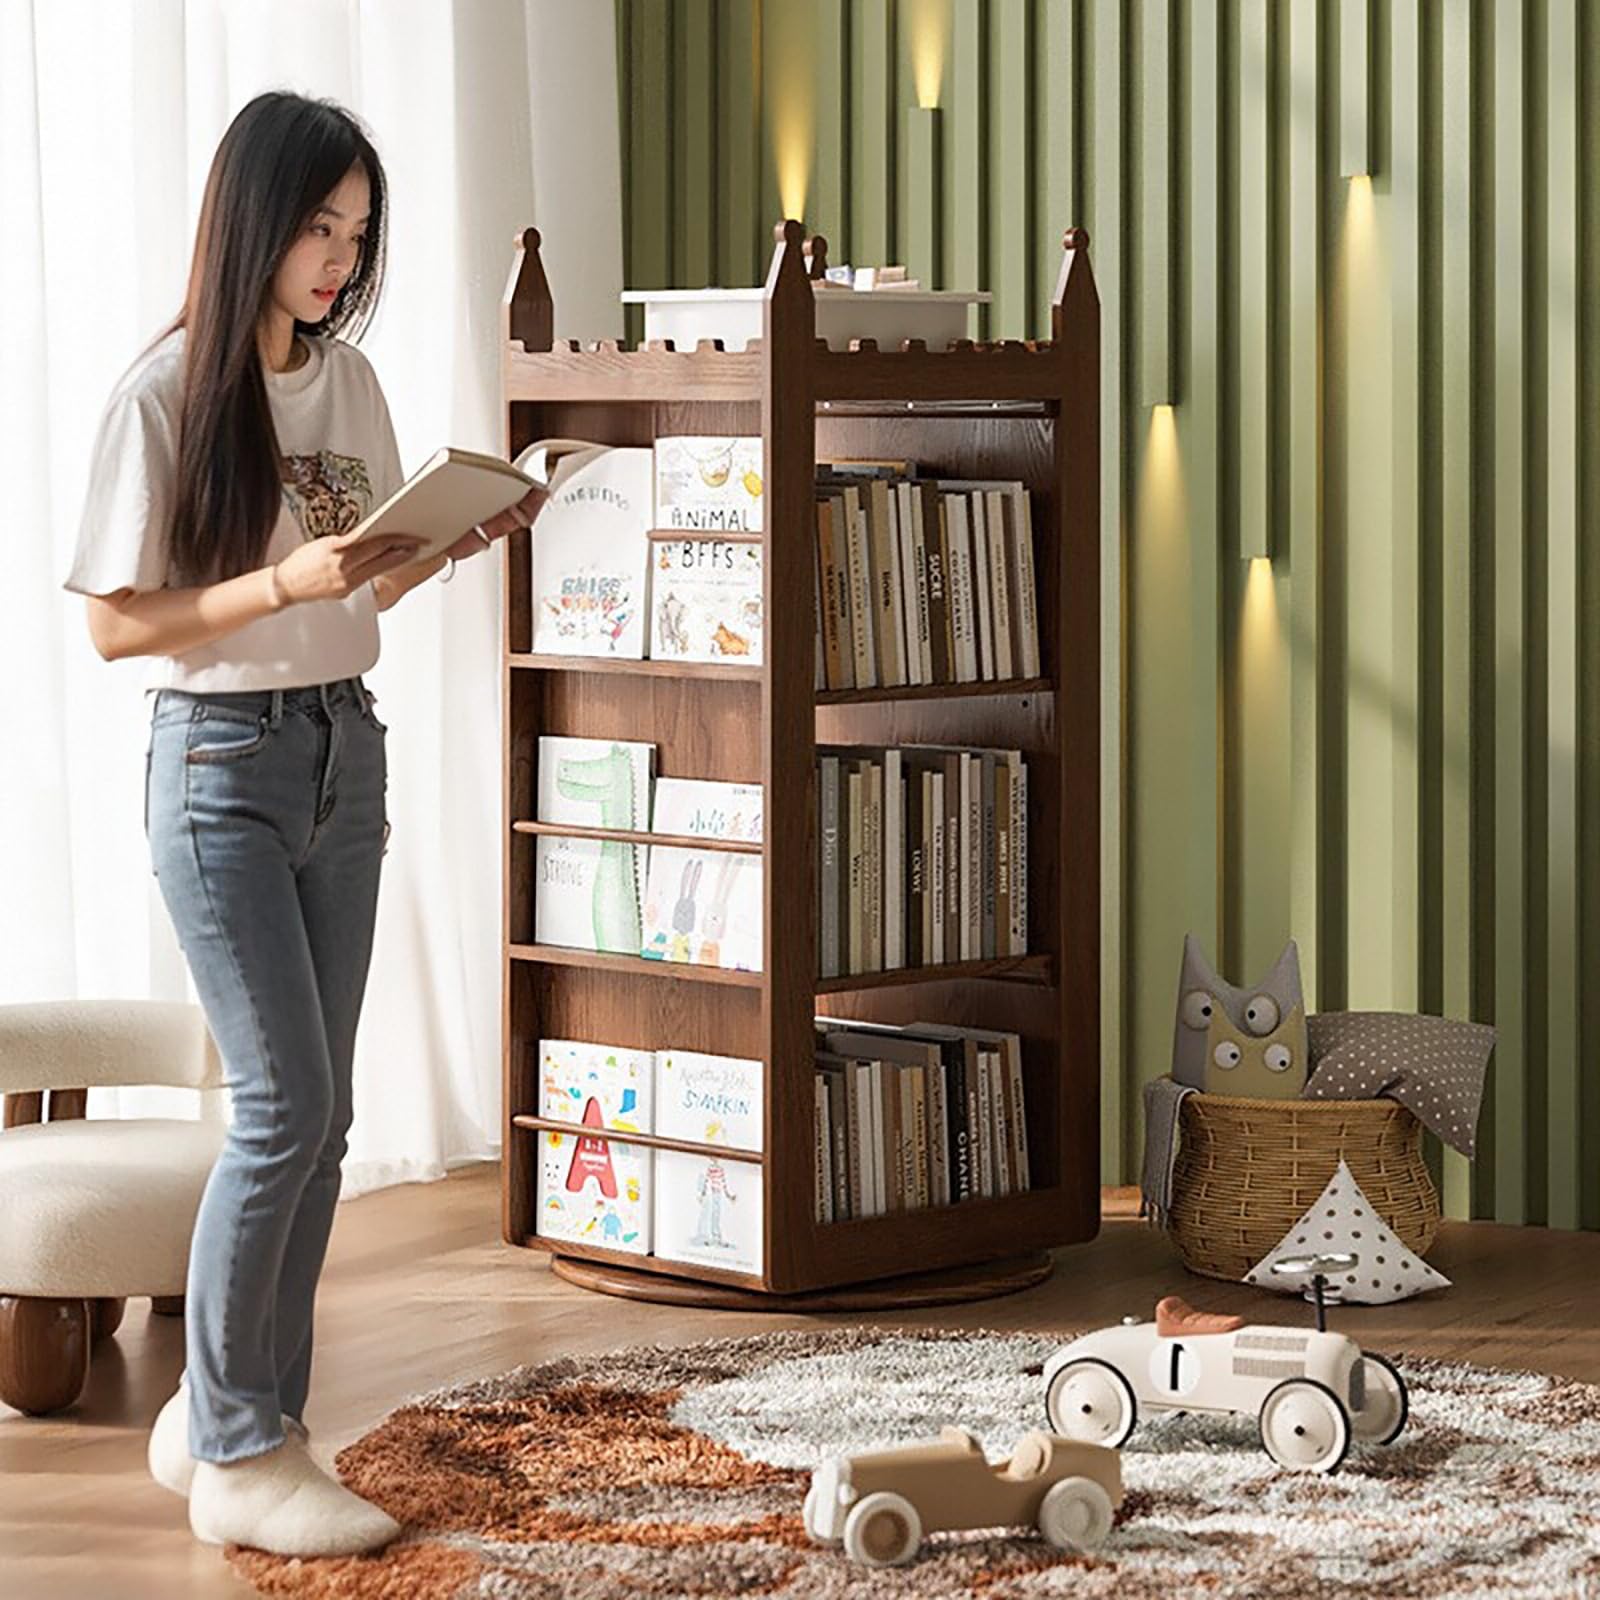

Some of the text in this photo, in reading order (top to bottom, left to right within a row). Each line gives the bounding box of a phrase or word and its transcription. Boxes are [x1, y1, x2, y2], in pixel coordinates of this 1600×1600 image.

[928, 553, 943, 600] SUCRE
[823, 827, 837, 865] Dior
[1170, 1343, 1186, 1391] 1
